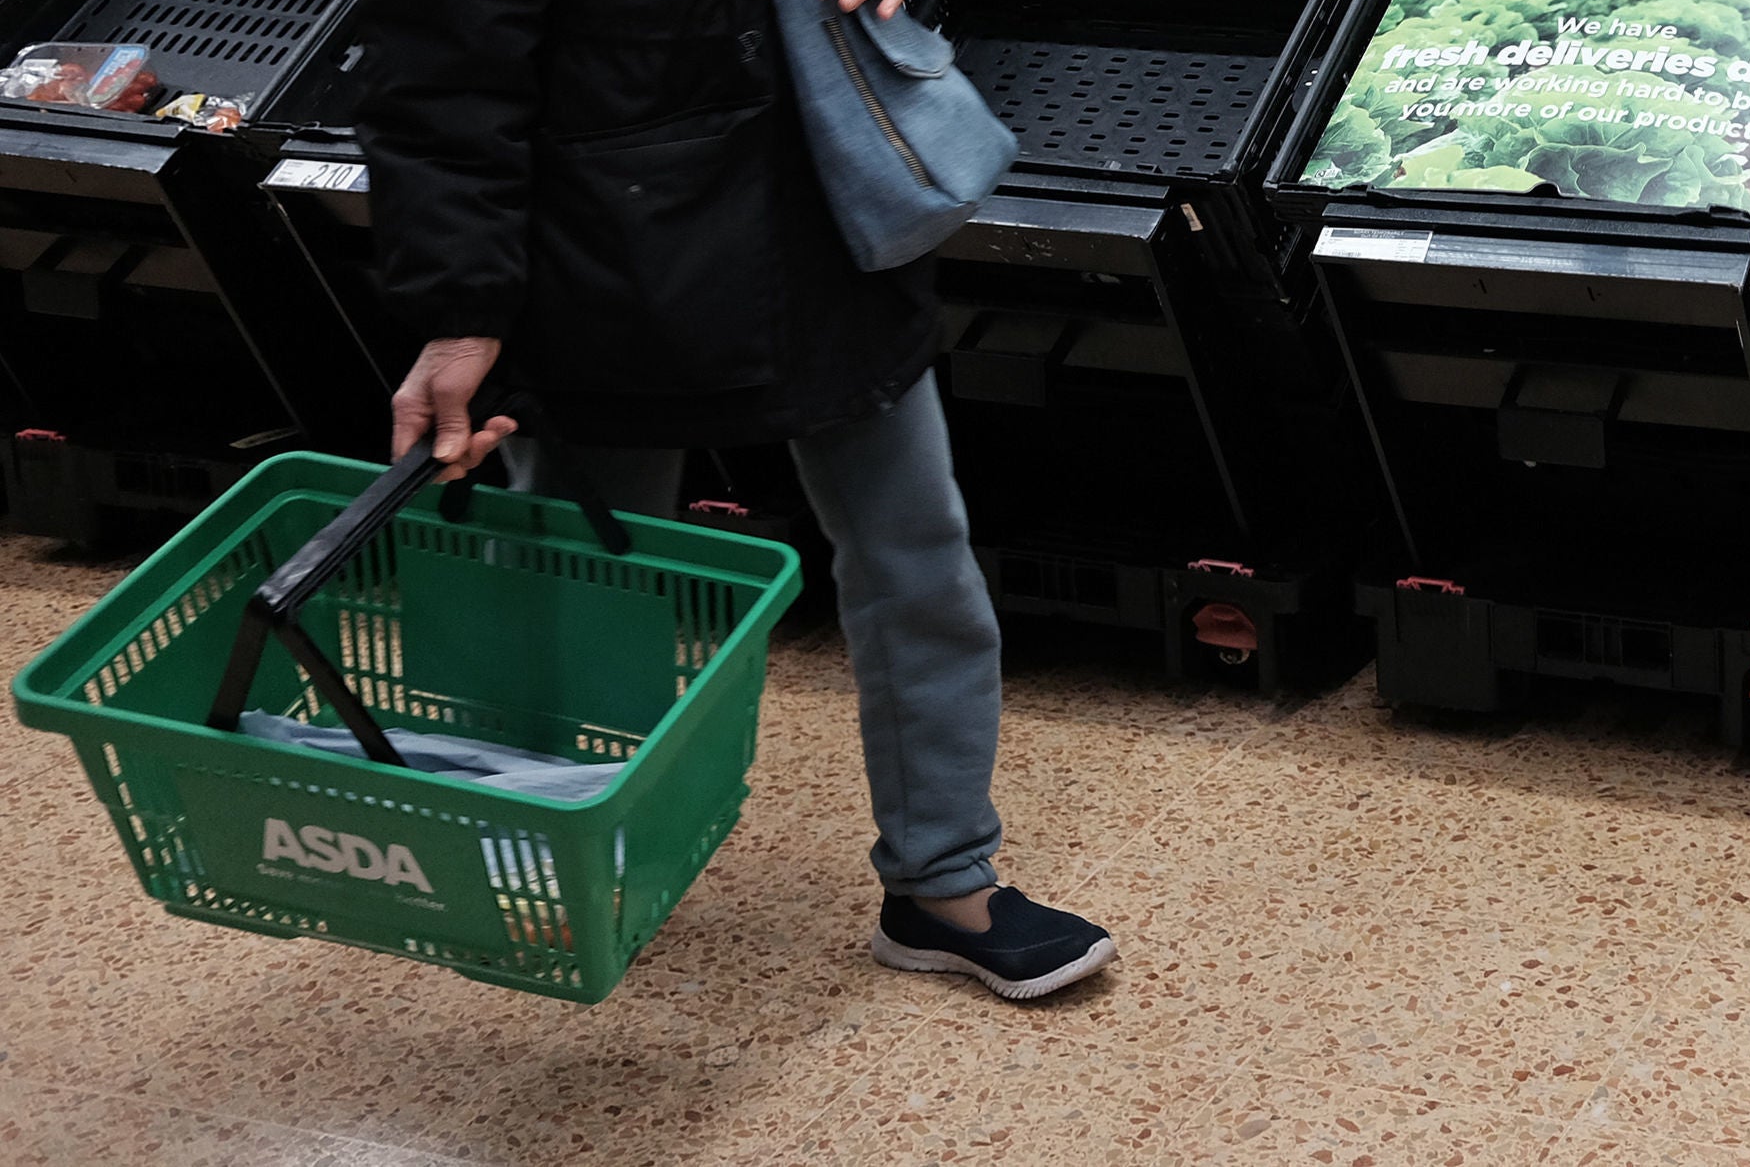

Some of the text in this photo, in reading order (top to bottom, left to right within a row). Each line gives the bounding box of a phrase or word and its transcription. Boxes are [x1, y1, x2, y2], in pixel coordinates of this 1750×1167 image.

[1557, 17, 1678, 39] We have
[1380, 40, 1490, 70] fresh
[1497, 40, 1719, 78] deliveries
[1384, 75, 1438, 93] and
[1441, 77, 1485, 91] are
[1494, 74, 1609, 98] working
[1616, 79, 1686, 101] hard
[1692, 88, 1724, 106] to
[1399, 102, 1453, 121] you
[1450, 102, 1531, 118] more
[1540, 102, 1574, 119] of
[1578, 107, 1629, 124] our
[263, 818, 435, 893] ASDA
